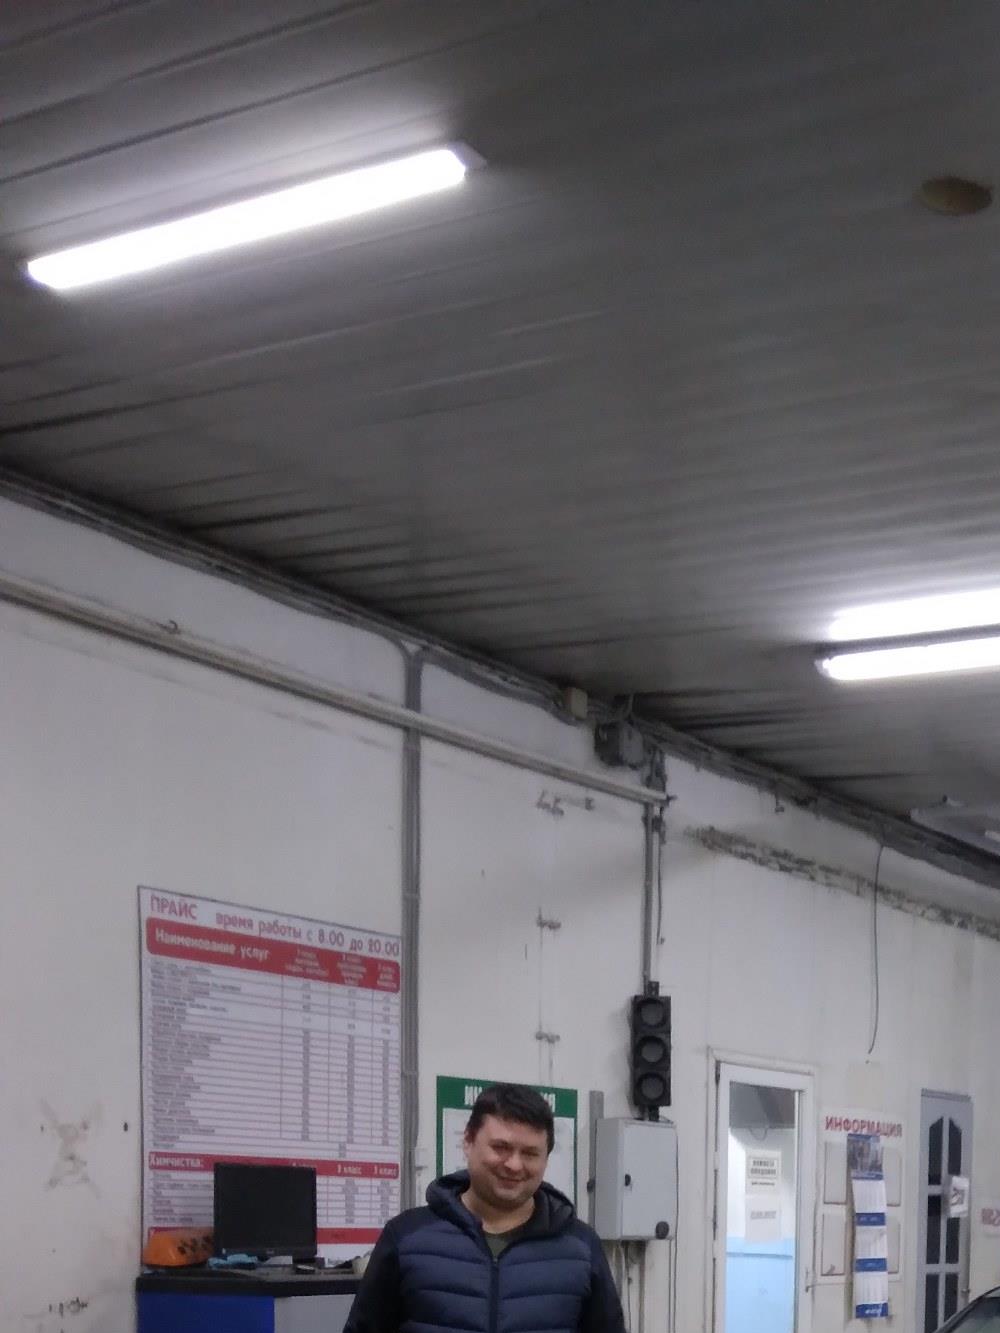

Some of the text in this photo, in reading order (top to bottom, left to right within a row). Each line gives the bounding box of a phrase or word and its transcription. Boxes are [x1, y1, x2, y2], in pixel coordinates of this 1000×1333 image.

[150, 894, 198, 920] ПРАЙС
[215, 912, 254, 930] время
[258, 918, 302, 938] работы
[349, 938, 363, 952] до
[155, 927, 236, 956] Наименование
[240, 945, 270, 962] услуг
[825, 1115, 902, 1138] ИНФОРМАЦИЯ
